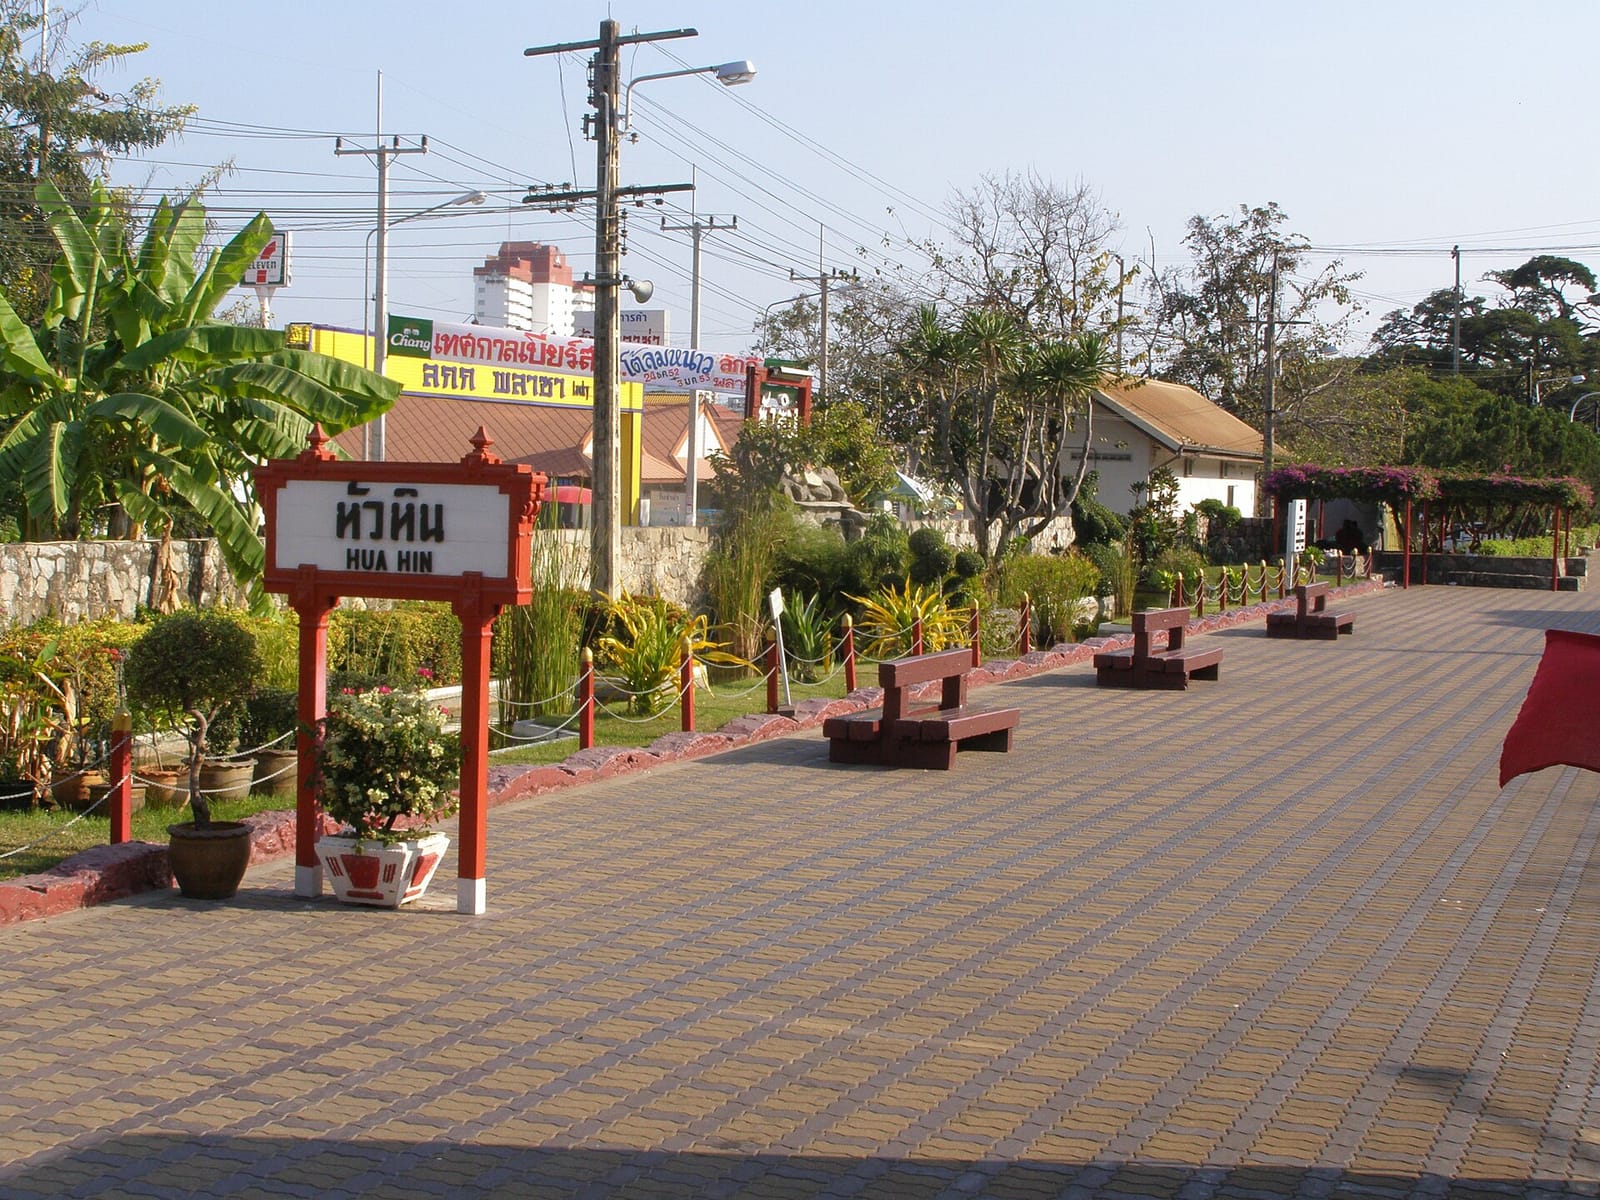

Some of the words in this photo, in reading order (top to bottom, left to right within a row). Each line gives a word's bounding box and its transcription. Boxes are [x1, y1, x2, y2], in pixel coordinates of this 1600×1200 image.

[390, 333, 431, 352] Chang
[346, 548, 388, 571] HUA
[397, 550, 433, 573] HIN
